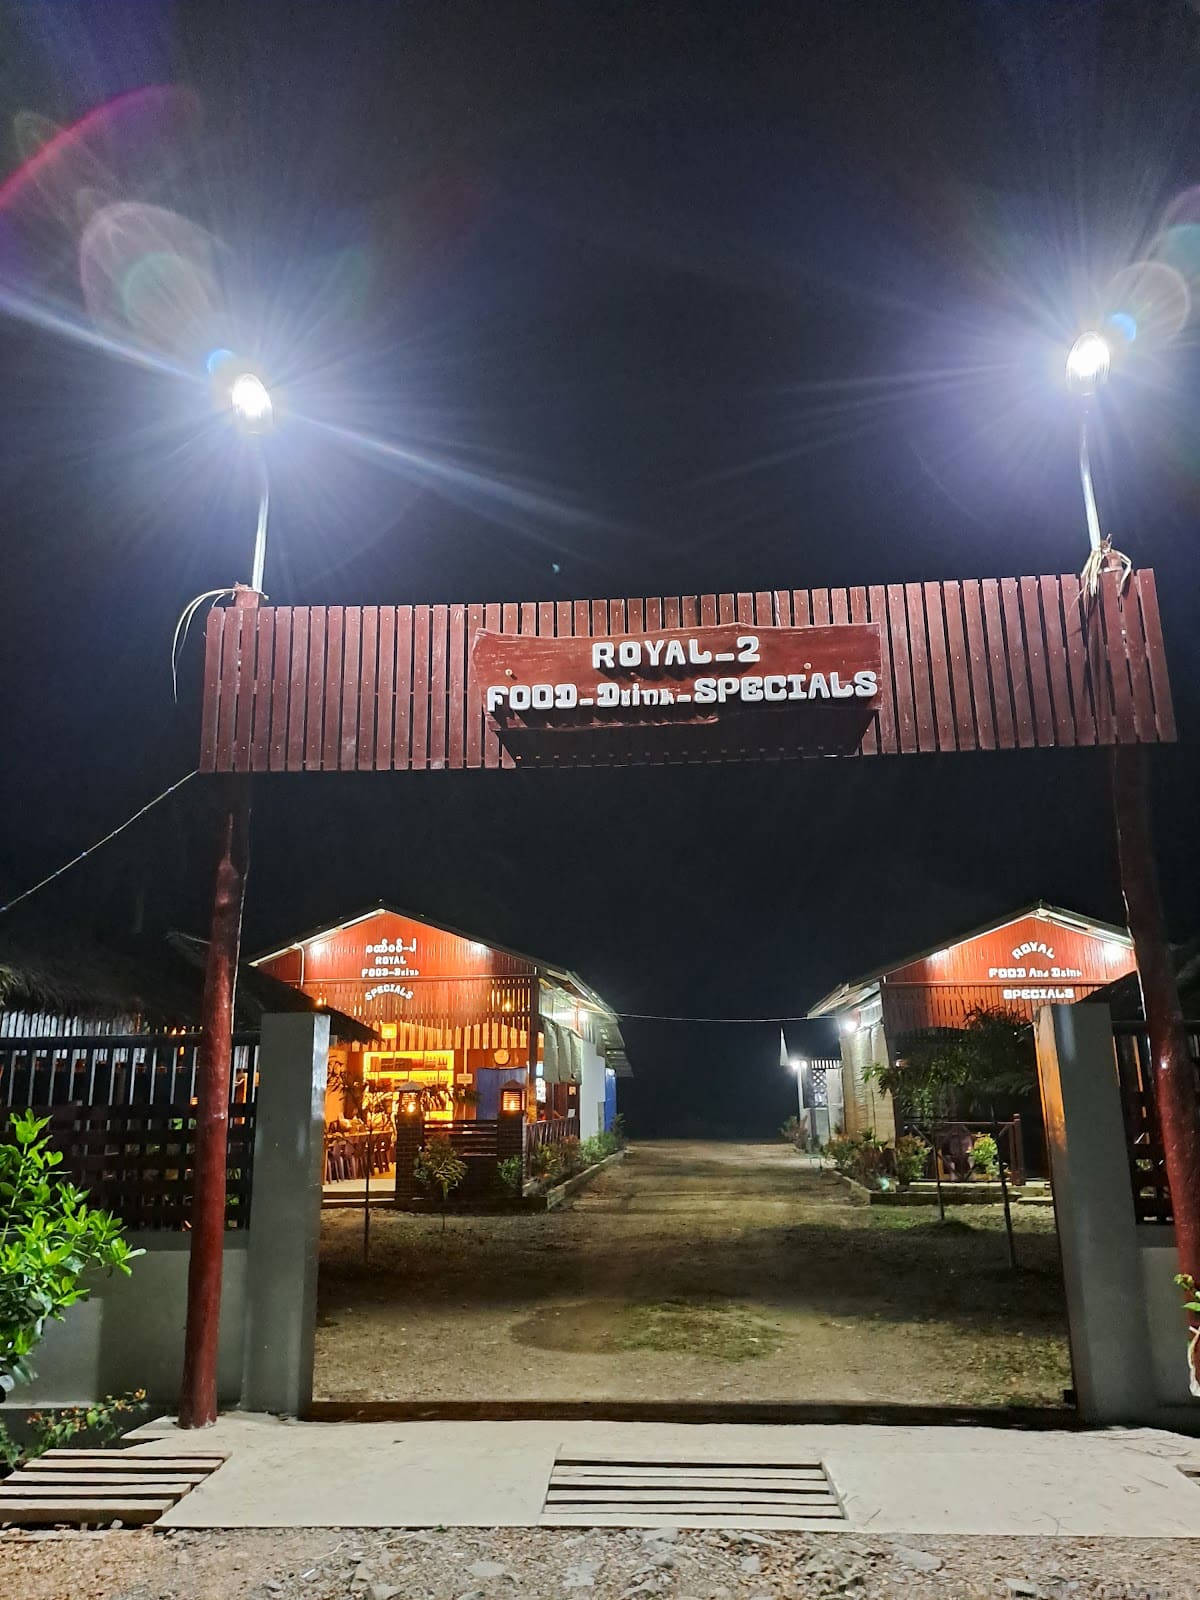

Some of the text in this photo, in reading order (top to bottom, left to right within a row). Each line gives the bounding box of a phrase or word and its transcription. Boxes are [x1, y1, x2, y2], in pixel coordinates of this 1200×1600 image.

[1011, 941, 1056, 960] ROYAL
[375, 955, 407, 965] ROYAL
[988, 967, 1027, 978] FOOD
[1028, 967, 1049, 978] And
[364, 983, 414, 1001] SPECIALS
[1003, 988, 1075, 1000] SPECIALS
